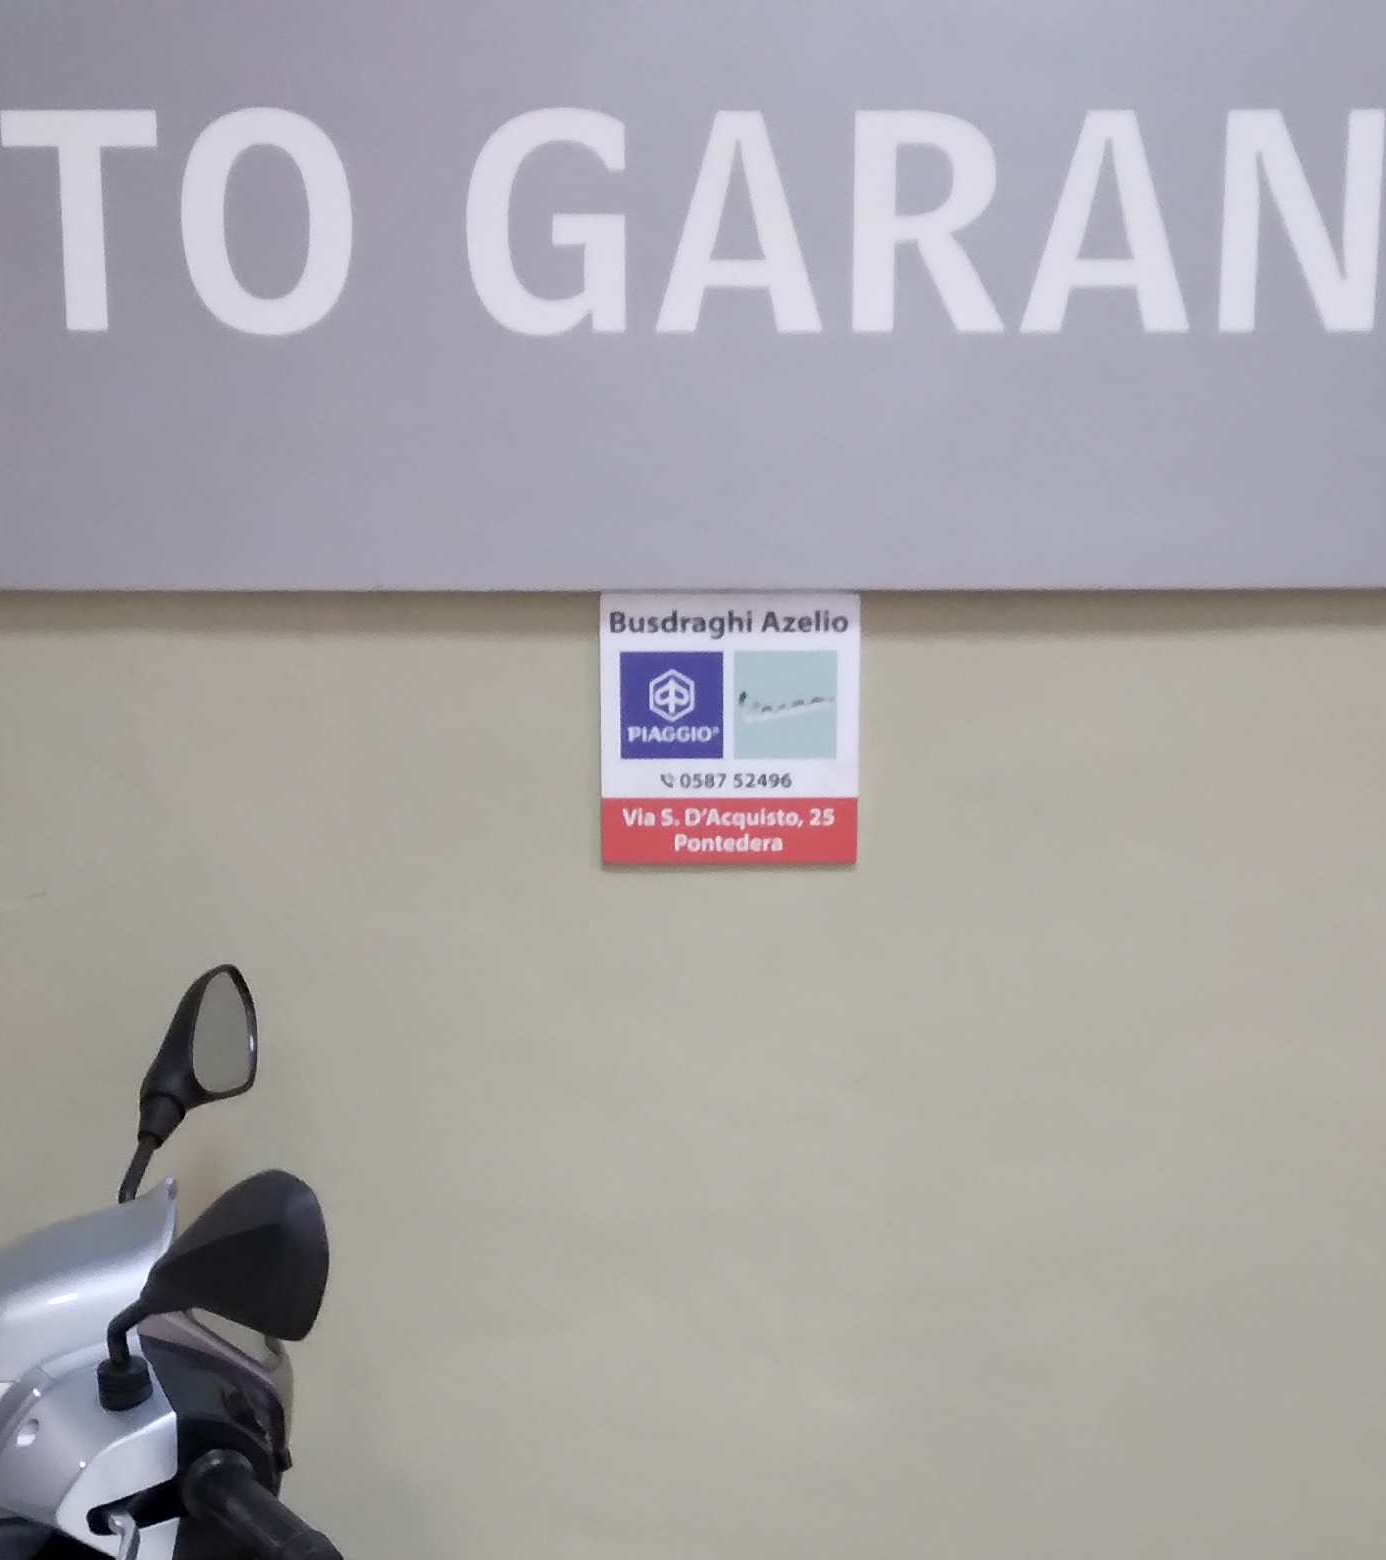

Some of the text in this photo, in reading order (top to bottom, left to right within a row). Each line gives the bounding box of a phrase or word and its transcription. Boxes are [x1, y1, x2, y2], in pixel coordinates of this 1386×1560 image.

[609, 610, 849, 639] Busdraghi Azelio
[679, 772, 793, 789] 0587 52496
[622, 807, 836, 830] Via S. D'Acquisto, 25
[673, 833, 784, 853] Pontedera
